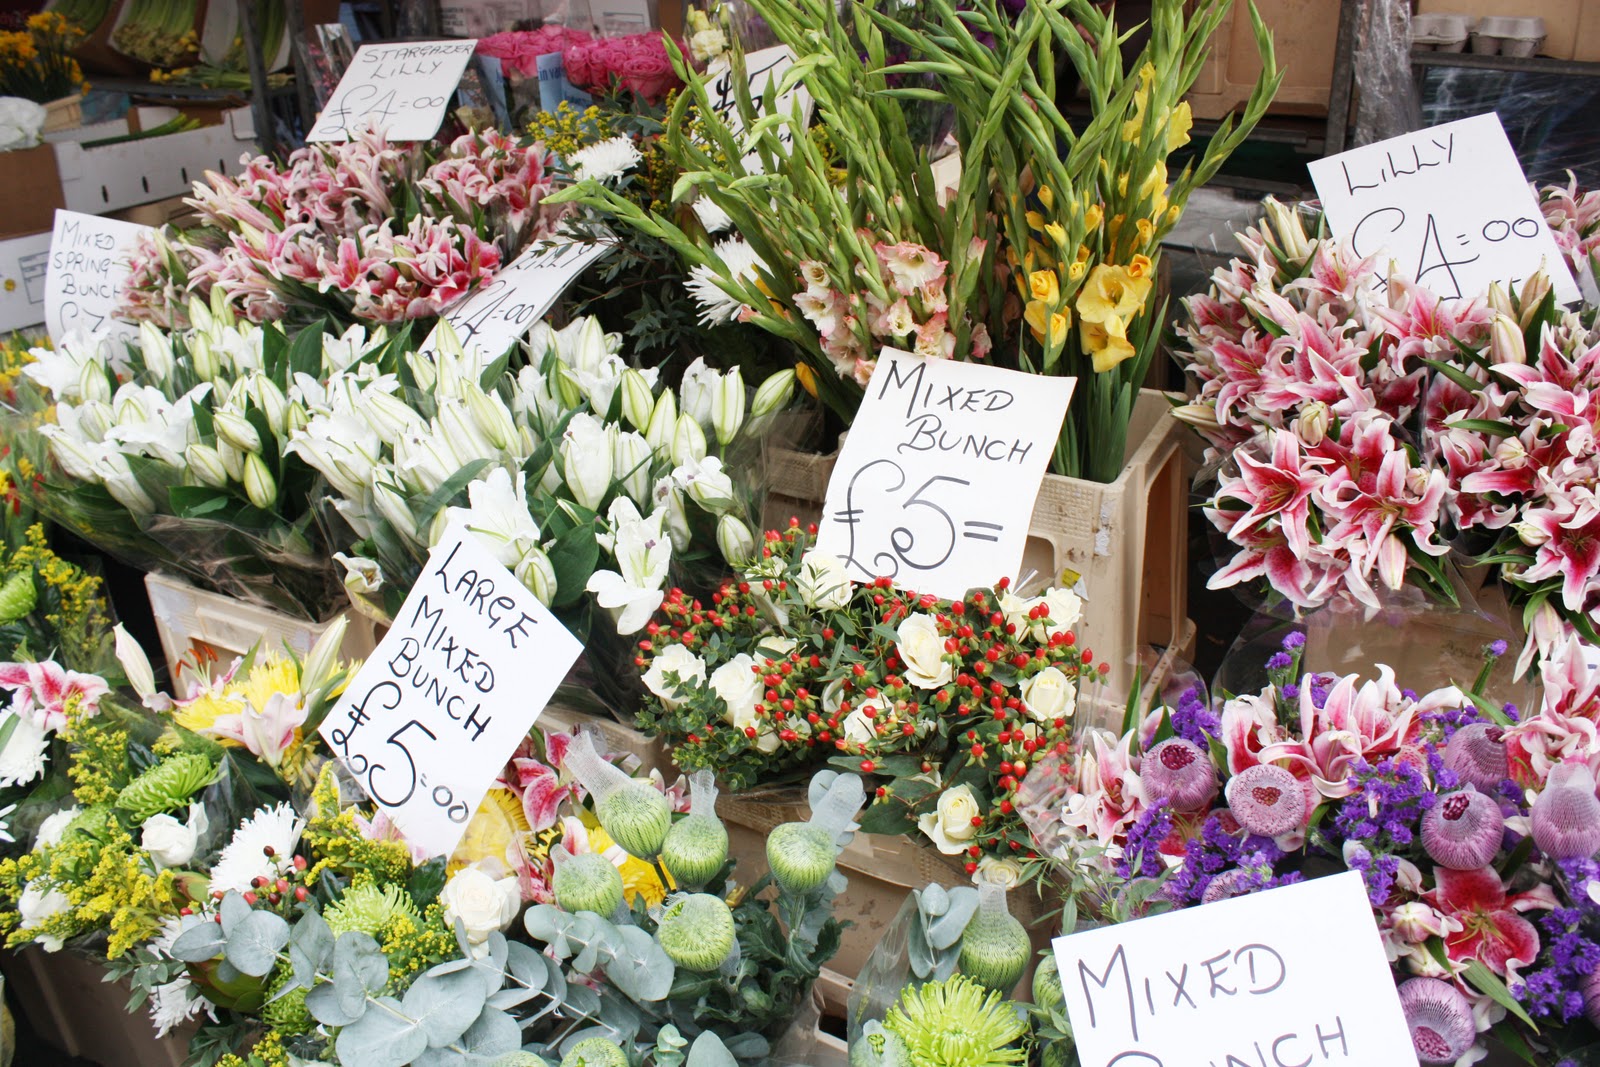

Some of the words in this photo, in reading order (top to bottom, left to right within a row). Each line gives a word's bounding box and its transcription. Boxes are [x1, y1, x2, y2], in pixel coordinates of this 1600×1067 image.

[362, 44, 474, 63] STARGAZER
[370, 61, 443, 79] LILLY
[1341, 133, 1453, 196] LILLY
[60, 220, 116, 250] MIXED
[53, 251, 111, 280] SPRING
[60, 273, 122, 299] BUNCH
[878, 359, 1014, 419] MIXED
[897, 413, 1033, 465] BUNCH
[435, 541, 538, 648] LARGE
[411, 595, 495, 693] MIXED
[388, 637, 492, 742] BUNCH
[1078, 943, 1286, 1042] MIXED
